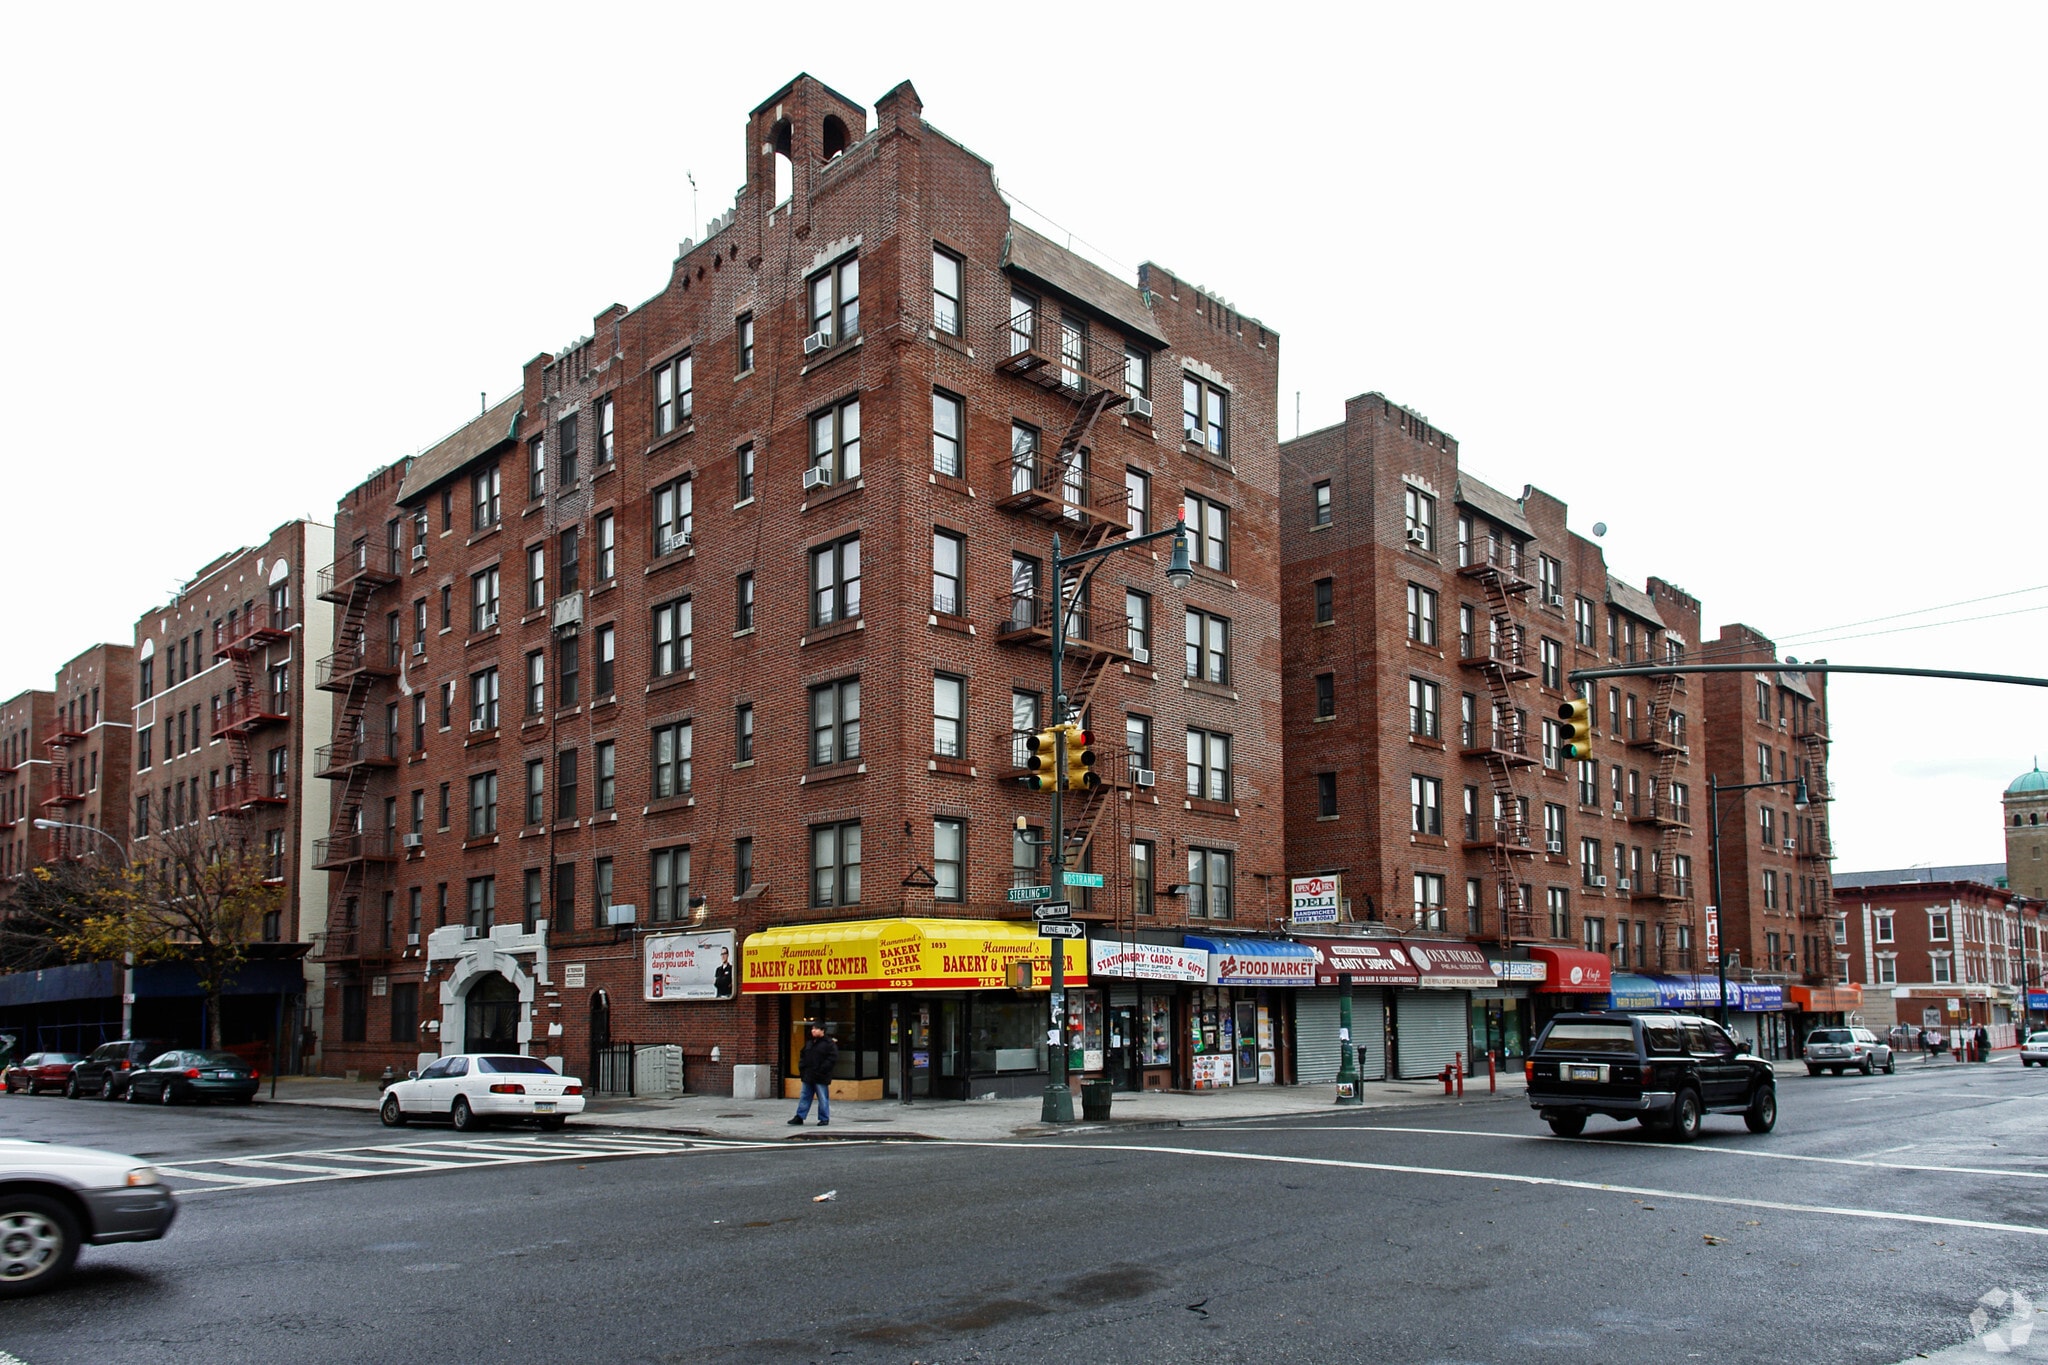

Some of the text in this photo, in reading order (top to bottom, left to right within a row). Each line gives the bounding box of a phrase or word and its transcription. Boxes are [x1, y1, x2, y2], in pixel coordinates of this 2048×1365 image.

[1064, 873, 1095, 885] NOSTRAND
[1009, 888, 1040, 899] STERLING
[1295, 884, 1309, 892] OPEN
[1310, 882, 1320, 893] 24
[1294, 897, 1334, 907] DELI
[1295, 908, 1334, 916] SANDWICHES
[879, 934, 921, 947] Hammond's
[1707, 912, 1719, 957] FISH
[781, 945, 833, 958] Hammond's
[880, 943, 921, 958] BAKERY
[981, 941, 1039, 953] Hammond's
[652, 951, 663, 959] Just
[664, 951, 674, 960] pay
[685, 948, 694, 956] the
[892, 954, 920, 966] JERK
[1426, 949, 1484, 963] ONE WORLD
[652, 961, 665, 970] days
[666, 961, 676, 969] you
[750, 957, 868, 978] BAKERY & JERK CENTER
[943, 955, 988, 972] BAKERY
[991, 958, 997, 971] &
[1097, 953, 1146, 971] STATIONERY
[1150, 954, 1173, 965] CARDS
[1177, 957, 1183, 967] &
[1187, 961, 1205, 978] GIFTS
[1240, 961, 1313, 975] FOOD MARKET
[1329, 958, 1396, 970] BEAUTY SUPPLY
[884, 965, 922, 975] CENTER
[778, 981, 837, 990] 718-771-7060
[1701, 990, 1730, 1000] MARKT
